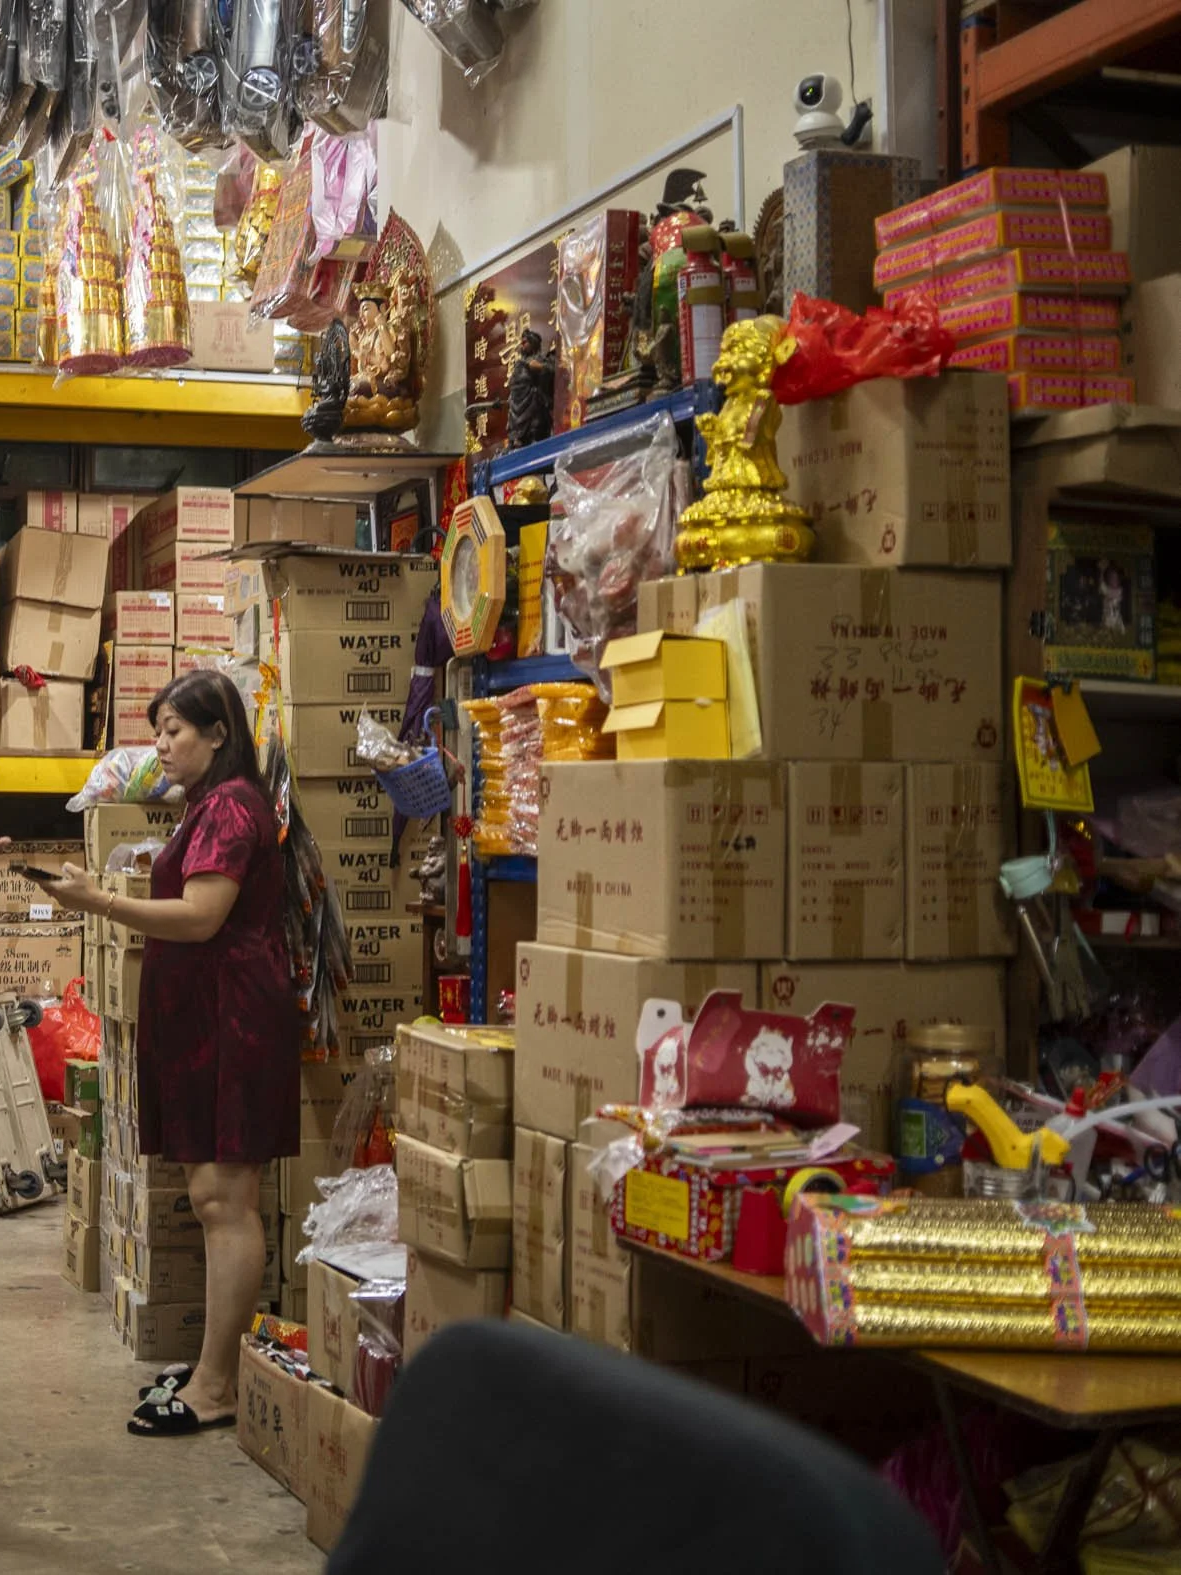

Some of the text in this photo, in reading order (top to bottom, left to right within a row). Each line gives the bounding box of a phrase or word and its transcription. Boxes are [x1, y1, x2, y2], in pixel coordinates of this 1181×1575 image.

[339, 562, 400, 577] WATER
[358, 580, 380, 593] 4U
[911, 625, 947, 640] MADE
[340, 635, 401, 649] WATER
[359, 650, 381, 665] 4U
[340, 709, 401, 723] WTER
[337, 780, 387, 794] WATE
[356, 796, 379, 810] 4U
[358, 868, 380, 882] 4U
[567, 879, 587, 894] MADE
[605, 882, 633, 897] CHINA
[3, 948, 30, 960] 38cm
[358, 941, 380, 956] 4U
[342, 998, 404, 1013] WATER
[361, 1014, 384, 1029] 4U
